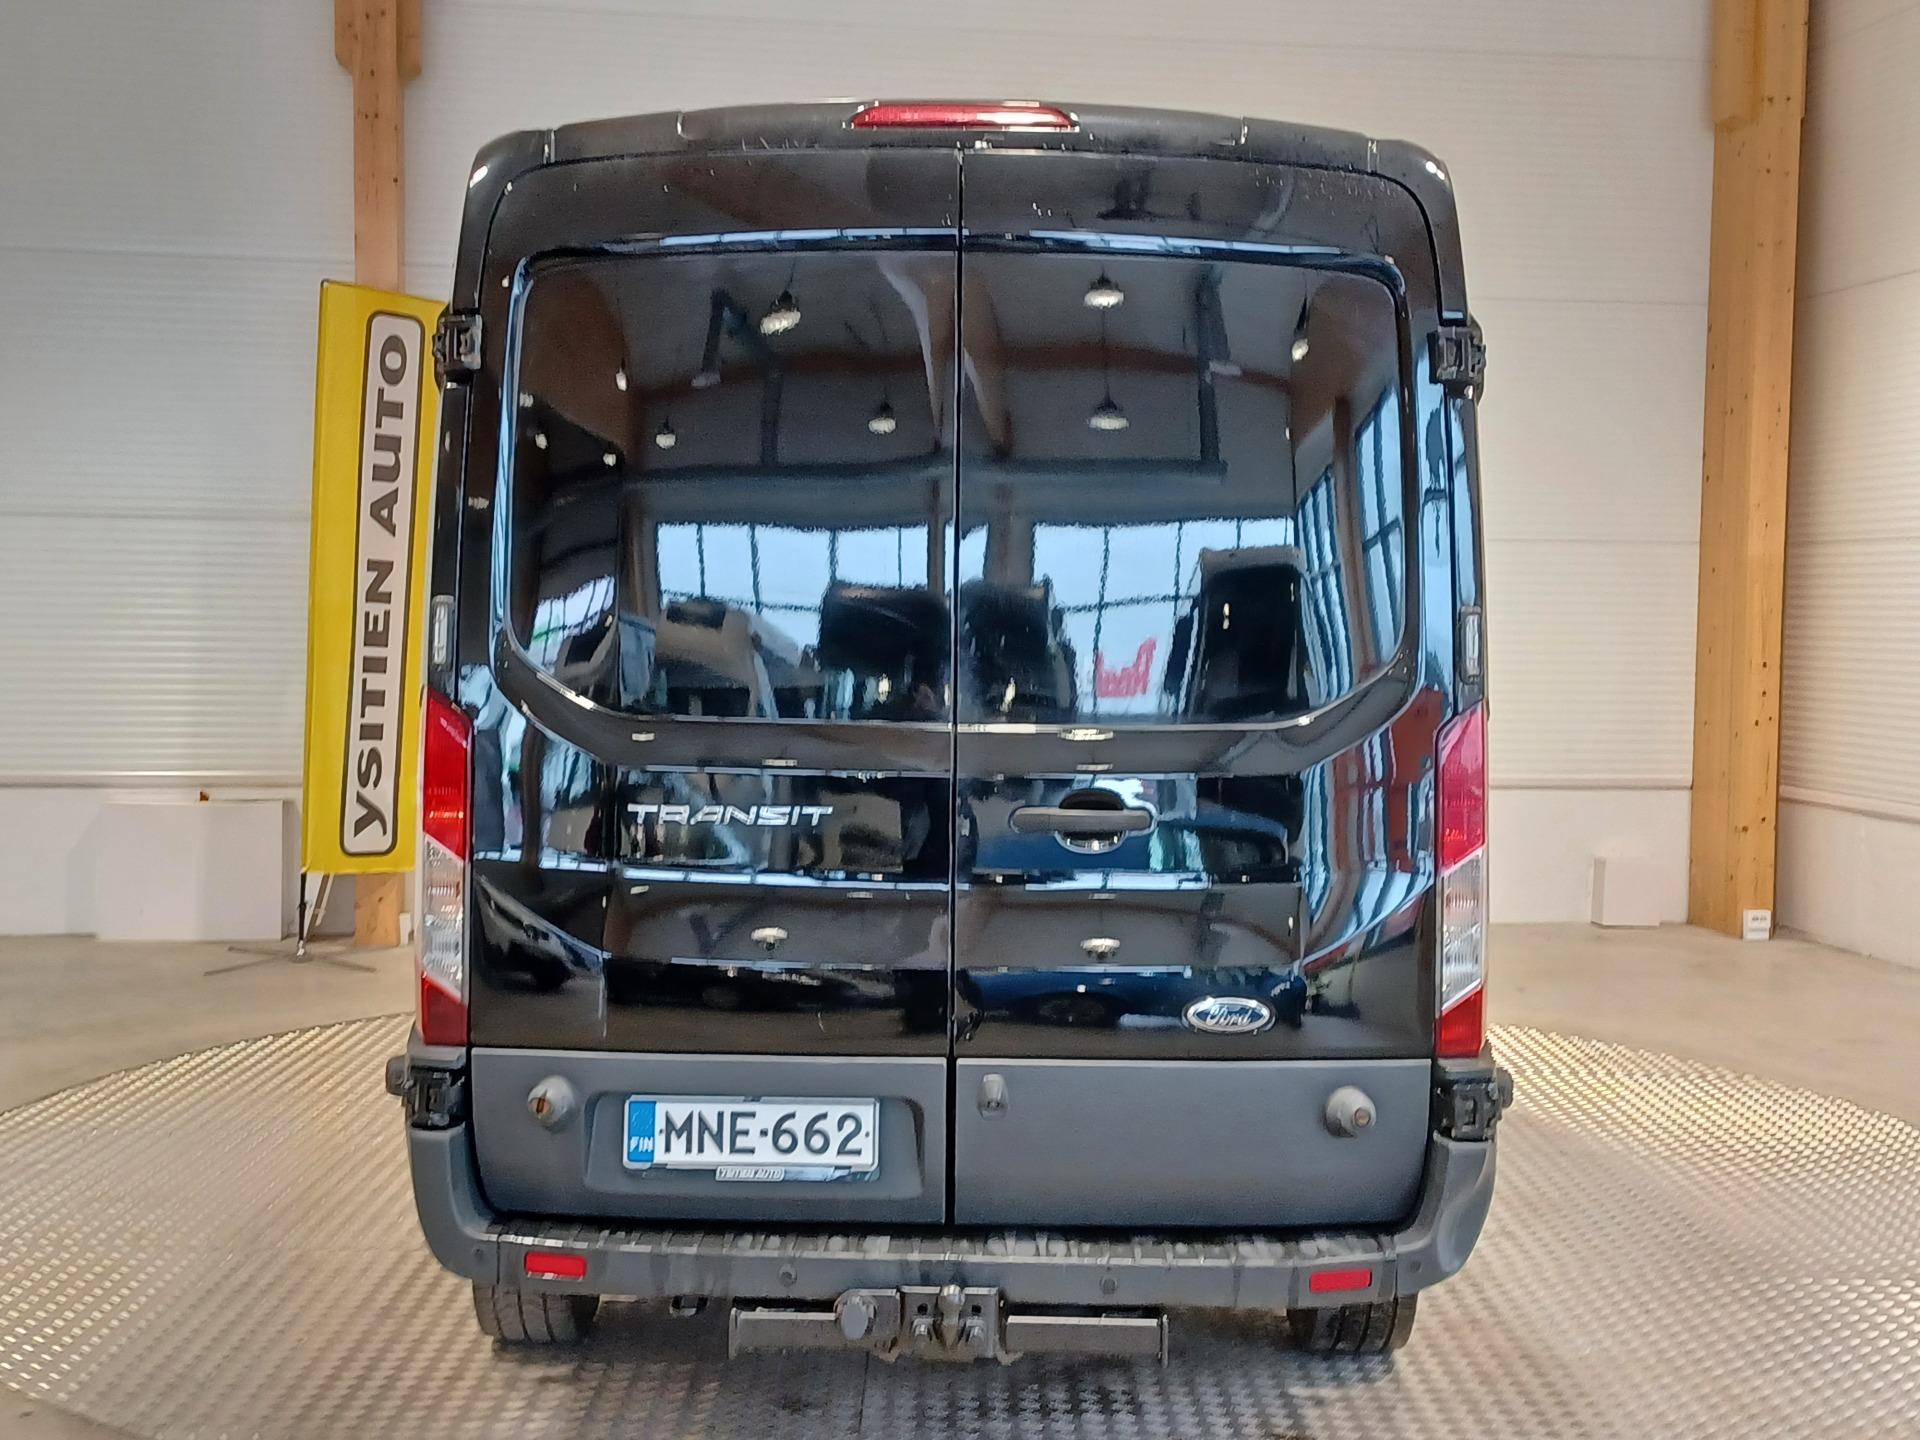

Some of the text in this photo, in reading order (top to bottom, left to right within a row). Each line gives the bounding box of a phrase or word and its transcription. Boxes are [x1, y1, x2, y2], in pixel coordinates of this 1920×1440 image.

[353, 334, 407, 838] YSITIEN AUTO
[627, 803, 833, 825] TRANSIT
[1206, 1004, 1252, 1026] Ford
[629, 1136, 654, 1152] FIN
[664, 1110, 863, 1156] MNE-662
